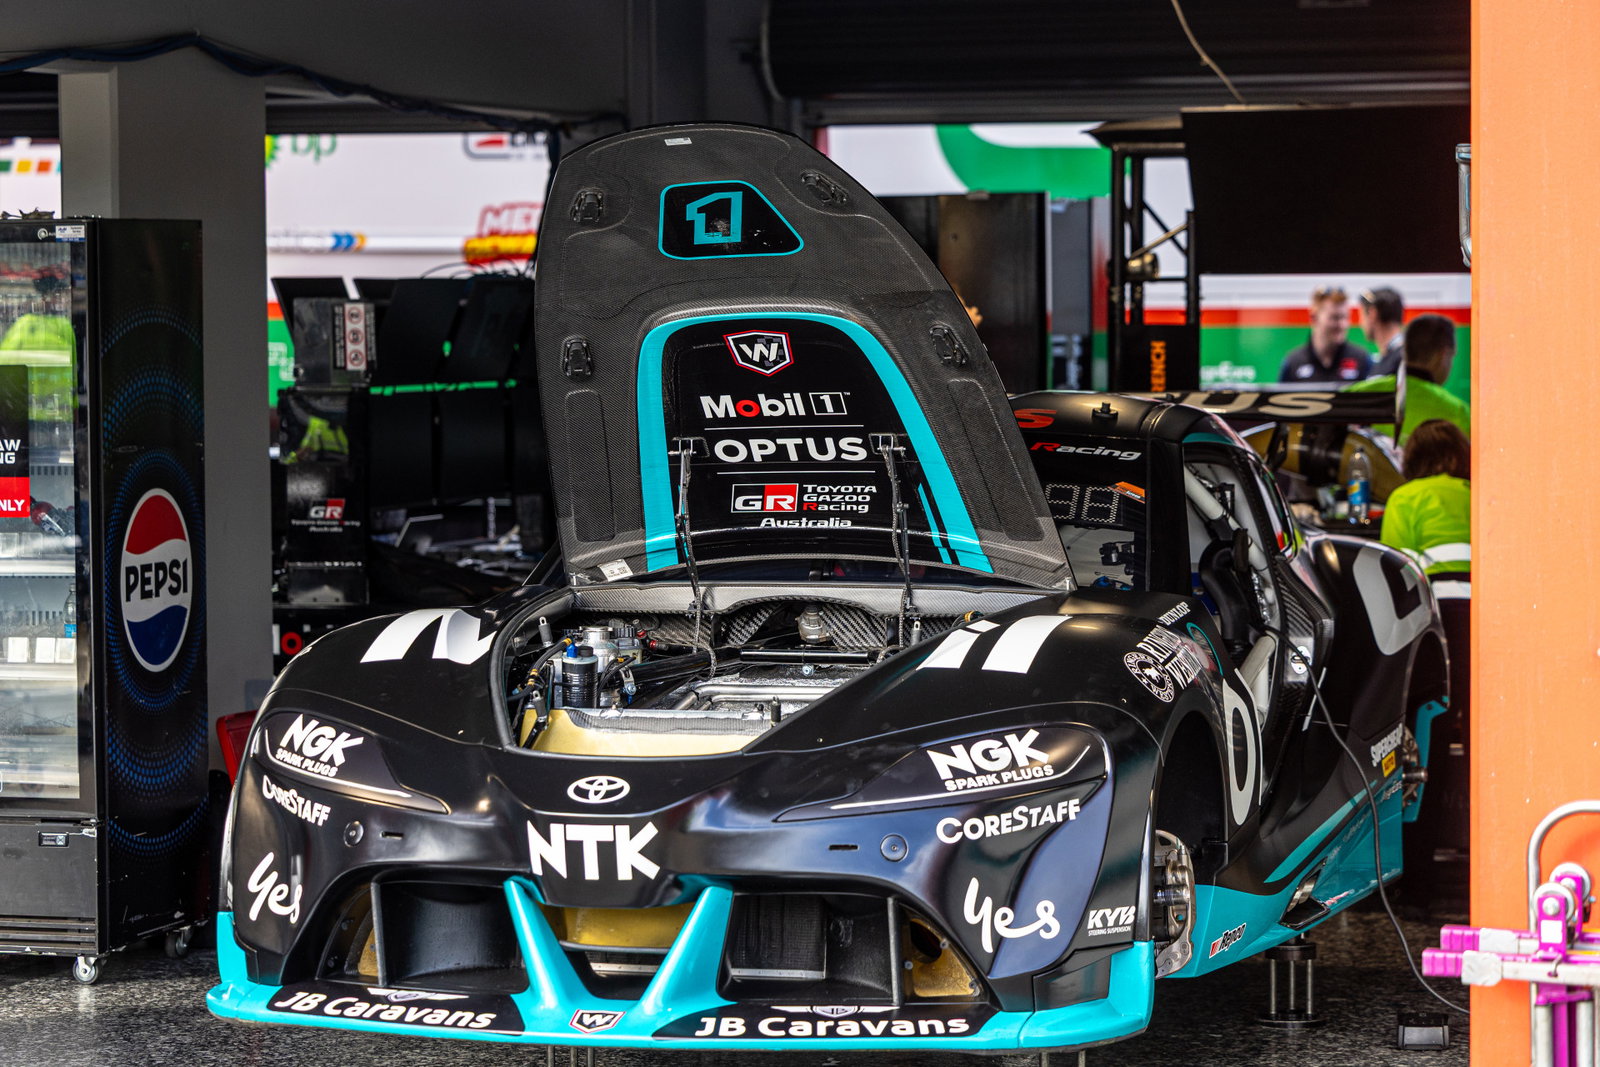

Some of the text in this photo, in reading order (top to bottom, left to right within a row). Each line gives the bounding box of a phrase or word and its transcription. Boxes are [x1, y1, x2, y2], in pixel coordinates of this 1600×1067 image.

[700, 393, 806, 418] Mobil
[714, 437, 868, 463] OPTUS
[1030, 441, 1142, 461] Racing
[734, 484, 877, 511] GR TOYOTA
[803, 493, 871, 502] GAZOO
[803, 502, 869, 514] Racing
[309, 505, 343, 519] GR
[760, 517, 852, 528] Australia
[125, 557, 188, 602] PEPSI
[1157, 601, 1191, 626] DUNLOP
[279, 713, 364, 767] NGK
[275, 748, 338, 777] SPARK PLUGS
[926, 728, 1050, 780] NGK
[945, 764, 1054, 791] SPARK PLUGS
[527, 820, 661, 881] NTK
[247, 851, 303, 924] yes
[963, 877, 1061, 953] yes
[1087, 905, 1136, 930] KYB
[275, 991, 497, 1029] JB Caravans
[694, 1016, 970, 1037] JB Caravans
